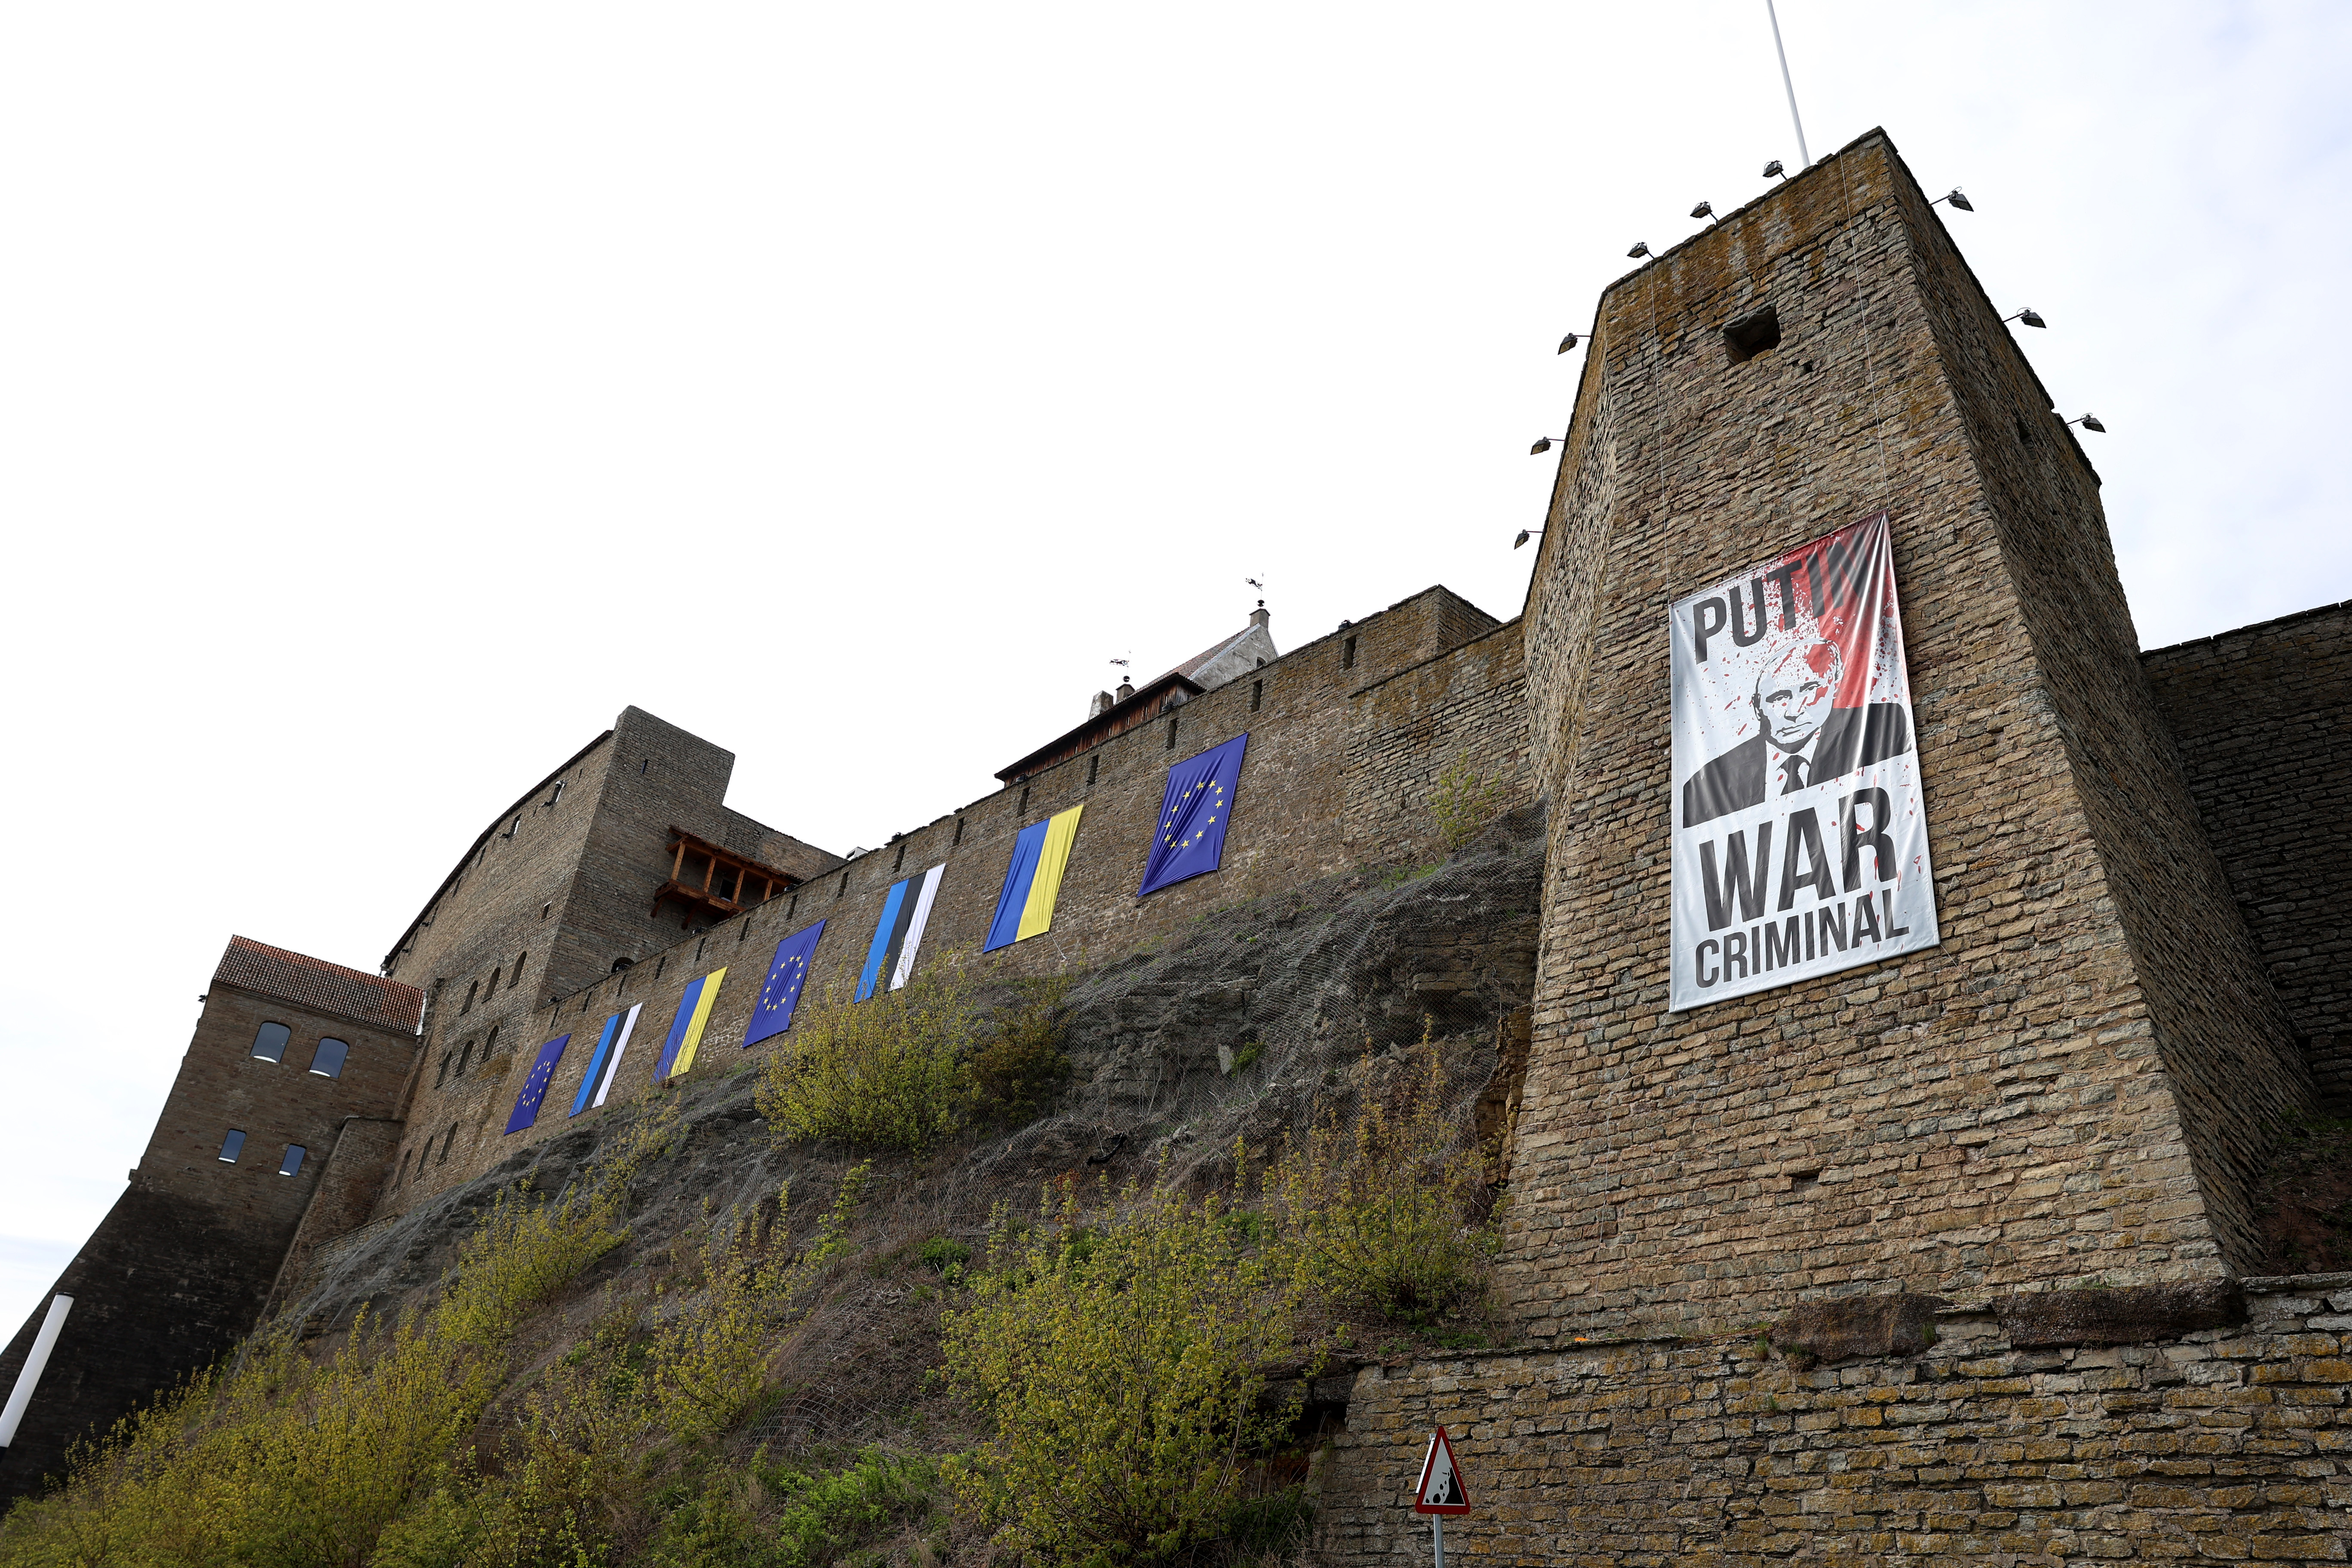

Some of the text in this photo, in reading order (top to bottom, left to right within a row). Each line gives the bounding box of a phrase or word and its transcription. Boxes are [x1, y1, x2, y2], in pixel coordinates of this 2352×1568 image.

[1693, 532, 1871, 665] PUTIN
[1699, 787, 1897, 932] WAR
[1695, 888, 1909, 988] CRIMINAL
